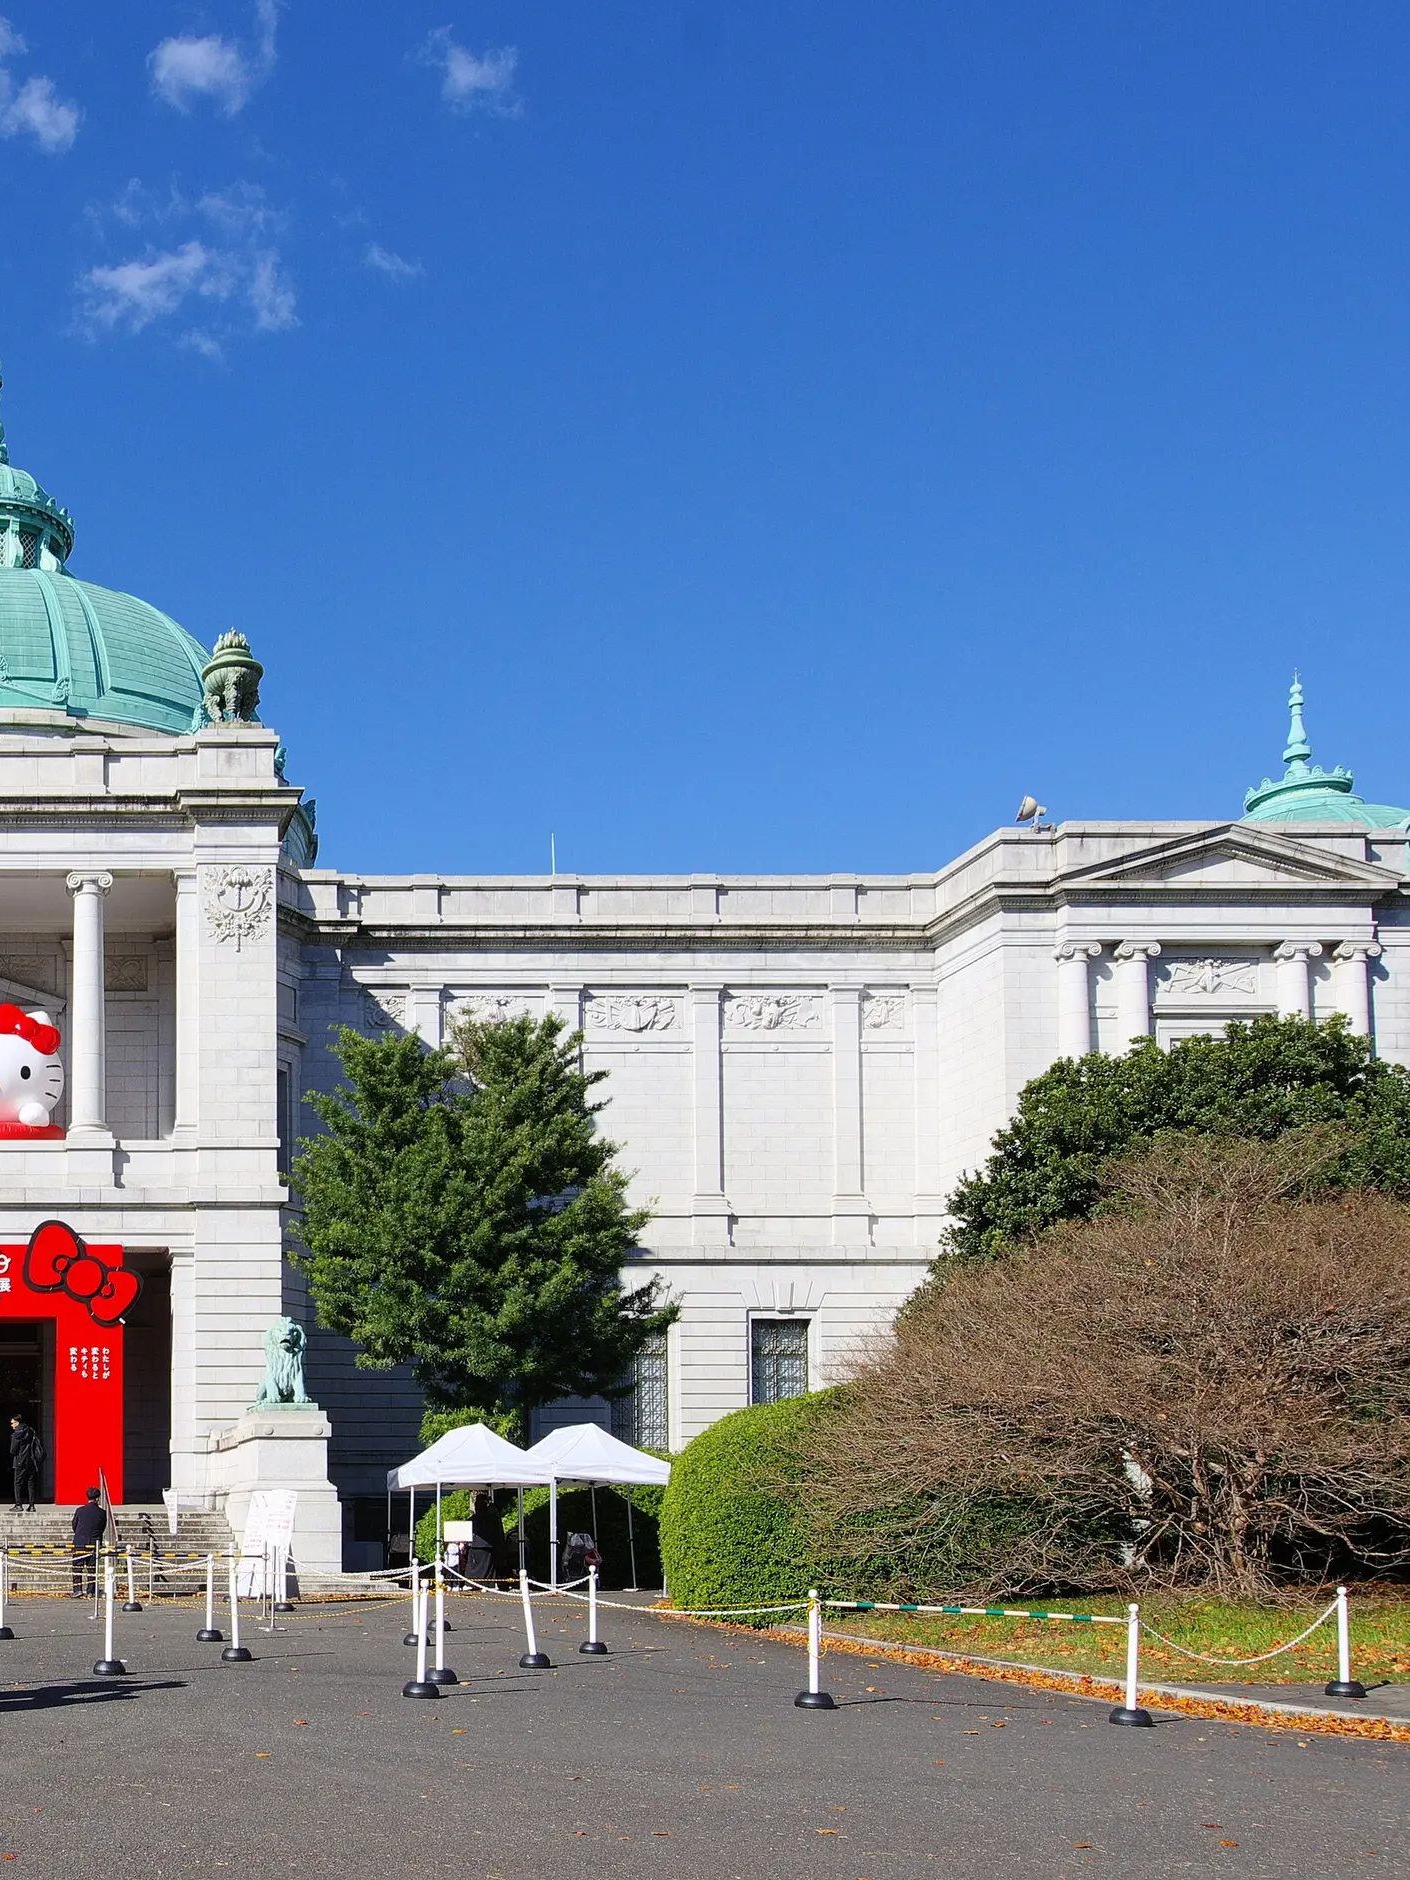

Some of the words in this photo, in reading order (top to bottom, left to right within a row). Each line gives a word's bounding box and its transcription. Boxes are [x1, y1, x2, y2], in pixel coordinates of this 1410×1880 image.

[69, 1347, 78, 1372] 変わる
[80, 1347, 88, 1378] キティも
[91, 1347, 100, 1380] 変わると
[102, 1347, 111, 1380] わたしが
